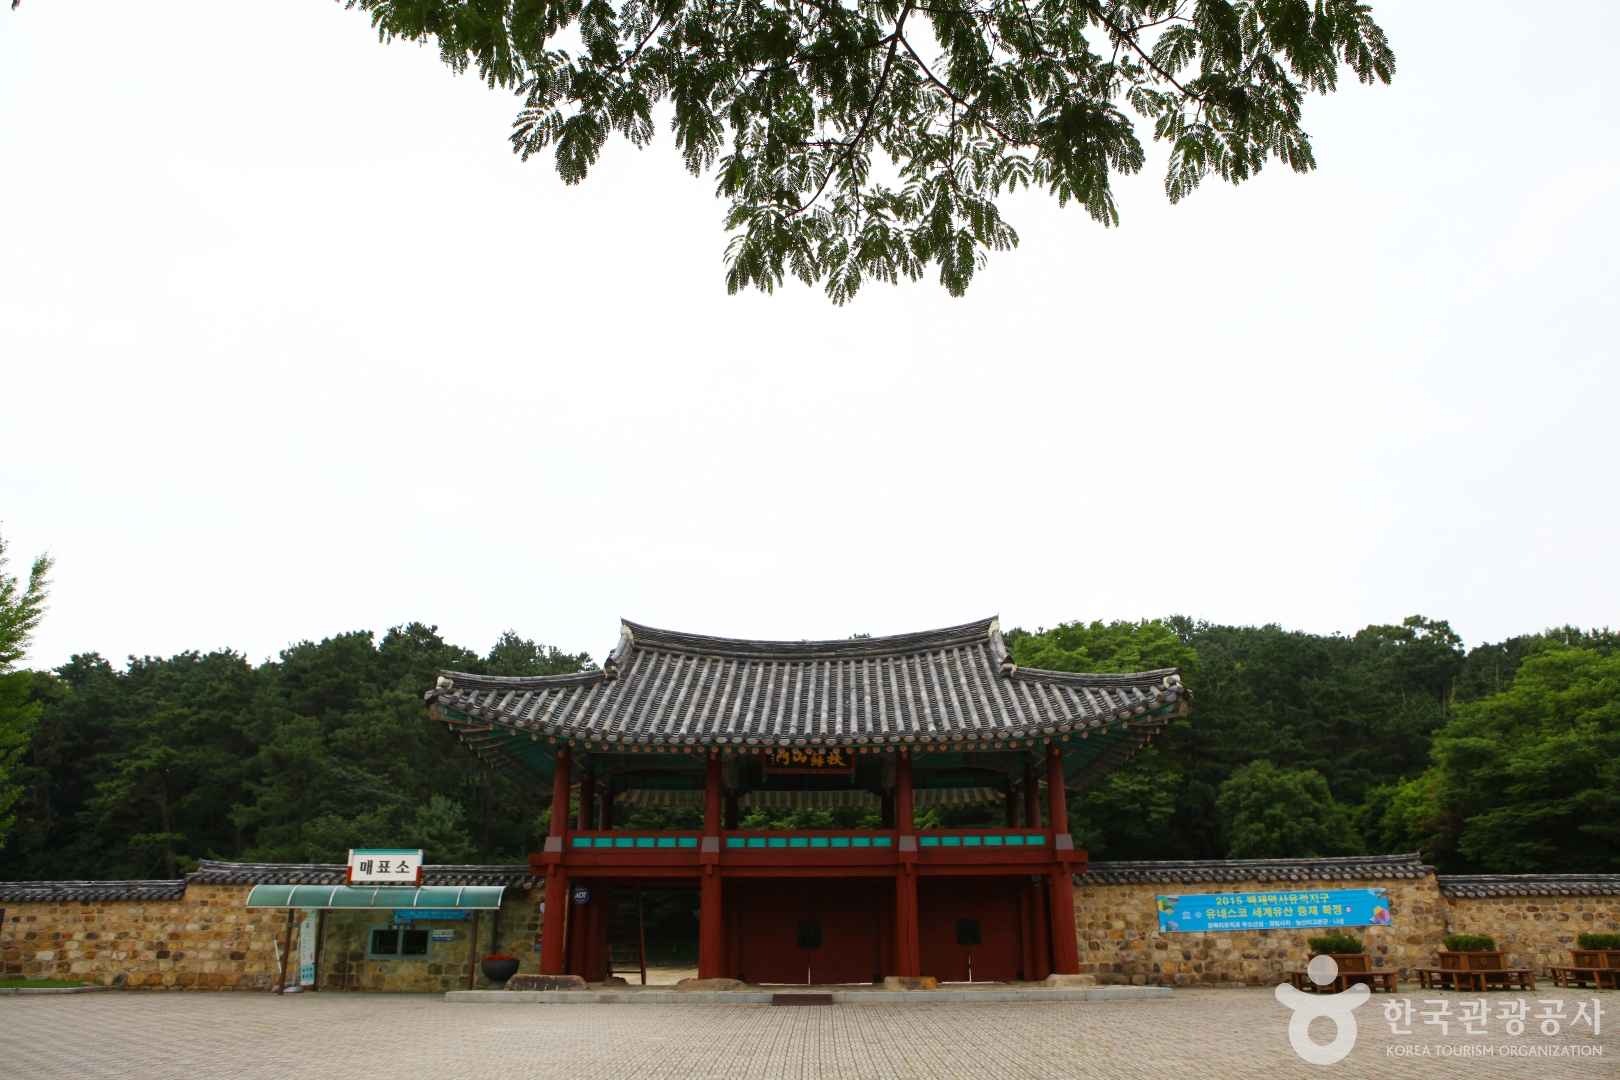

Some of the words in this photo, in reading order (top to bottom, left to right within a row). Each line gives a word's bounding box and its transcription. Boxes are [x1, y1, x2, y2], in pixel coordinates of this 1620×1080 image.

[360, 859, 410, 875] 매표소
[1215, 896, 1243, 906] 2015
[1206, 907, 1249, 919] 유네스코
[1252, 905, 1293, 917] 세계유산
